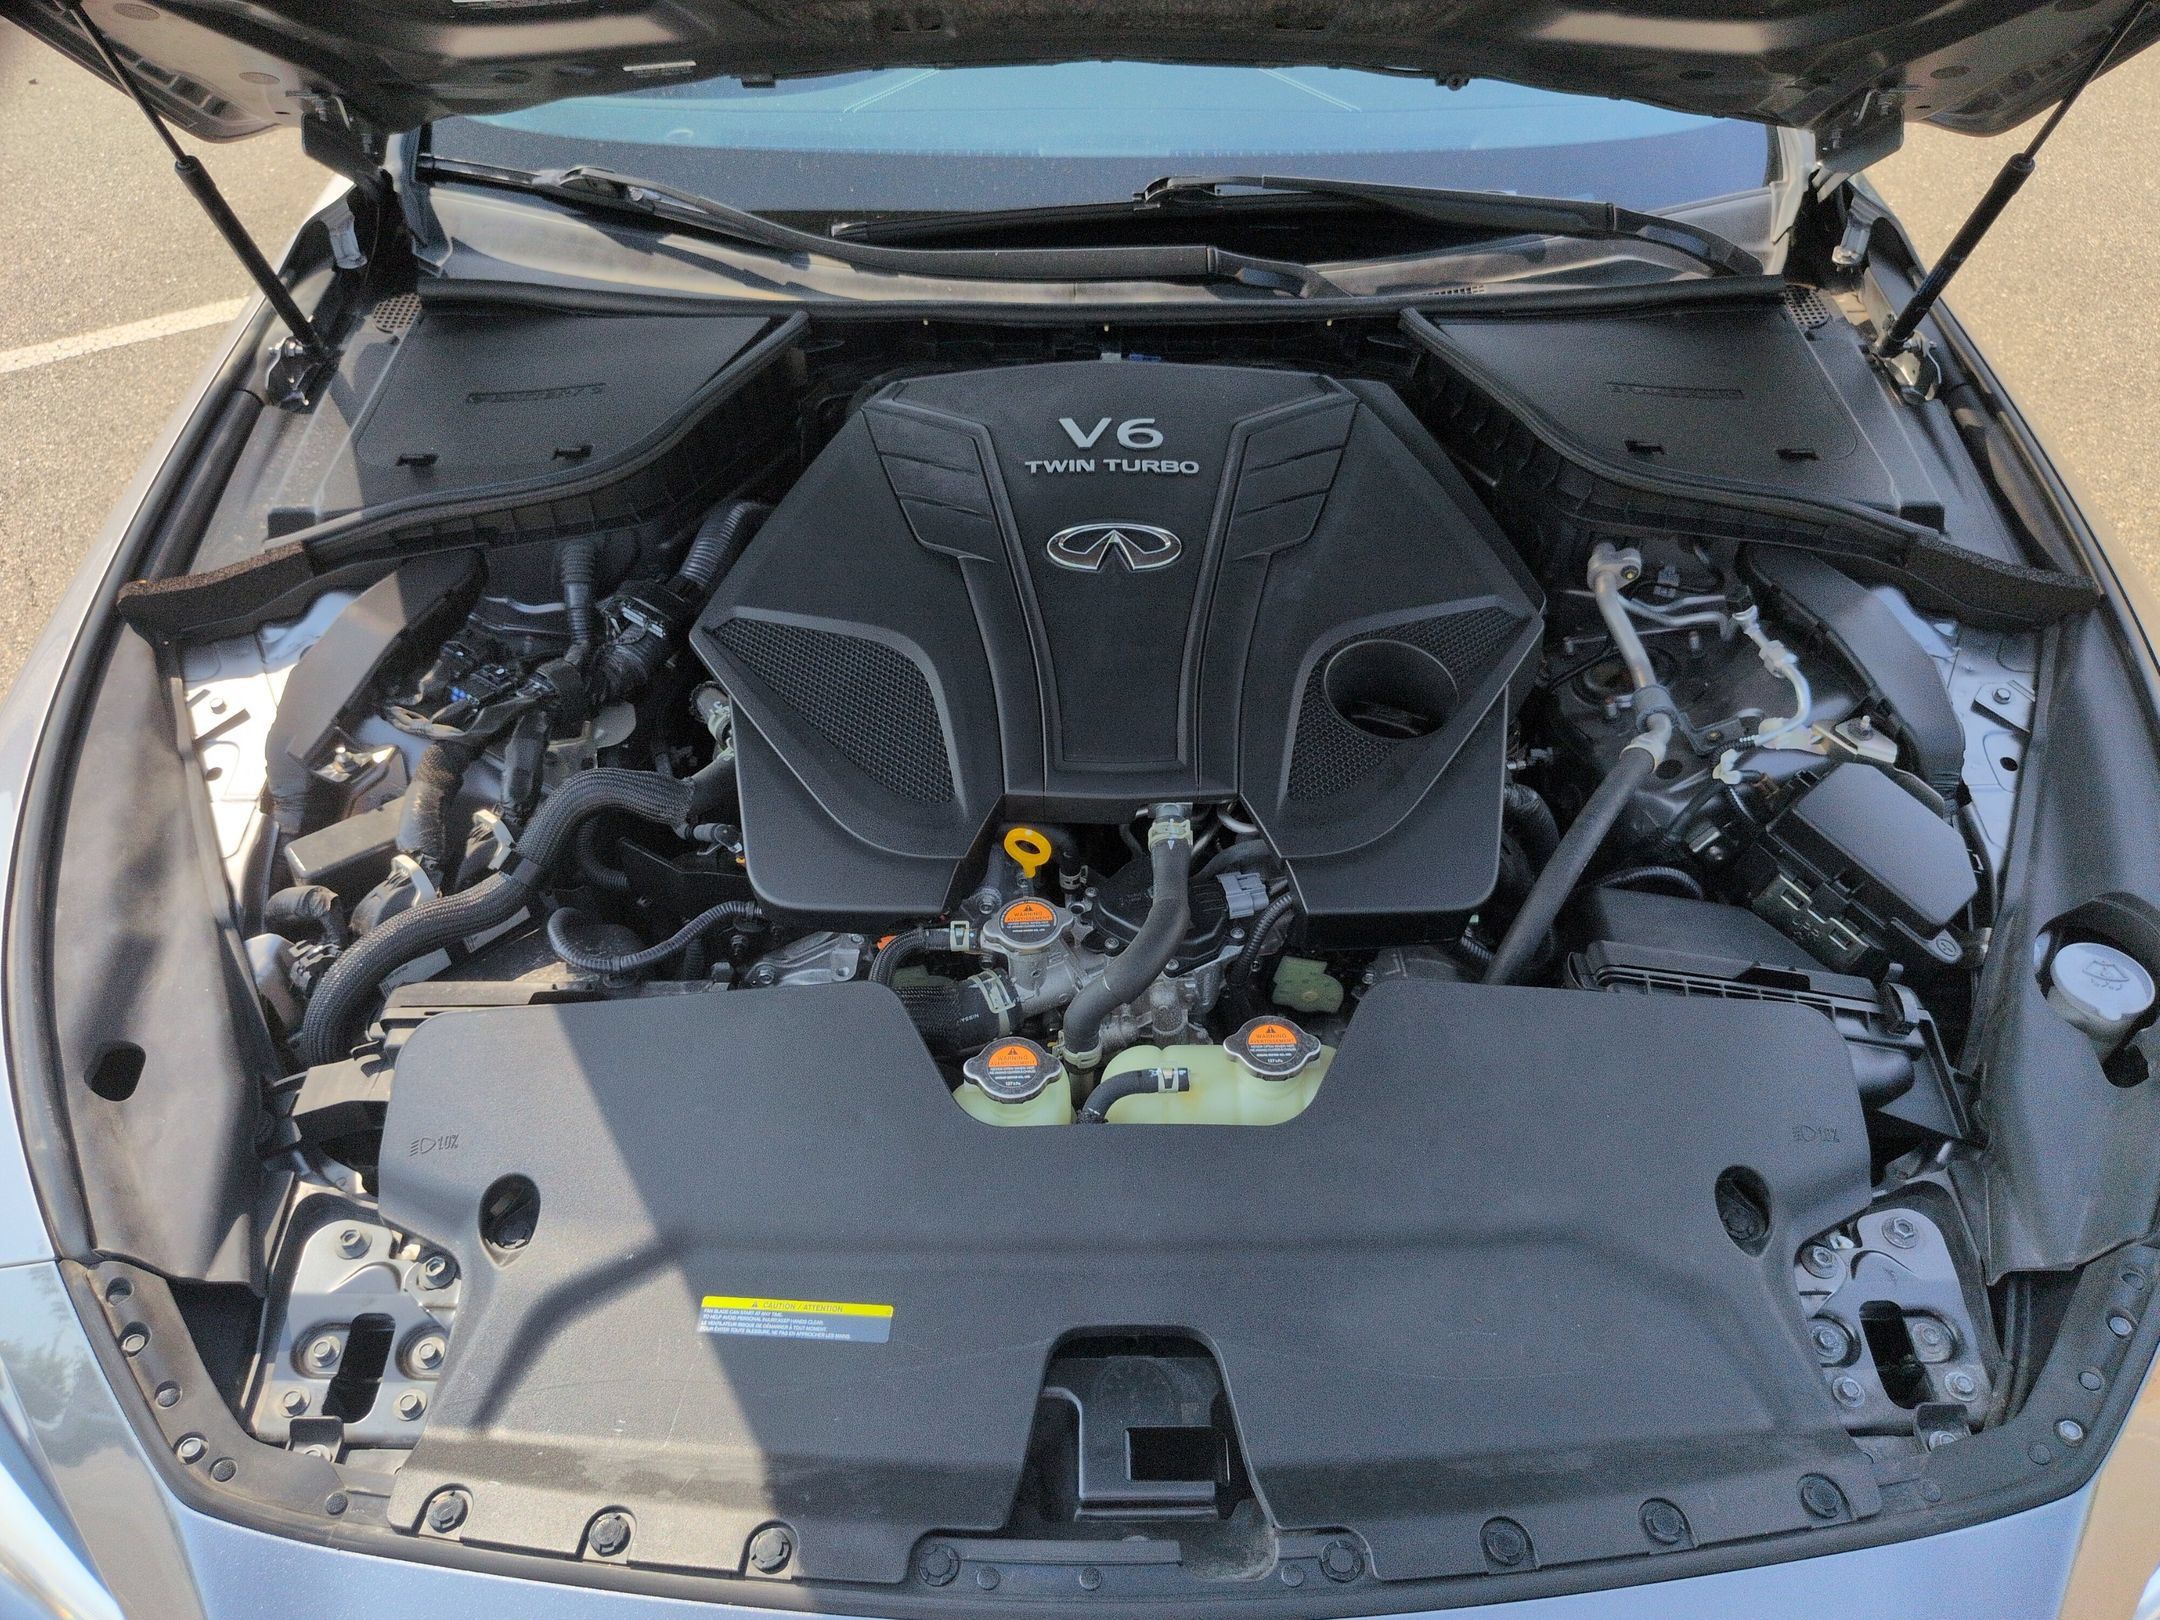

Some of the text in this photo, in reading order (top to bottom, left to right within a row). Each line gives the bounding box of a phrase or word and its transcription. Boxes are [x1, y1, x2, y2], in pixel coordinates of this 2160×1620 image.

[1058, 417, 1164, 449] V6
[1025, 459, 1200, 475] TWIN TURBO
[764, 1301, 795, 1309] CAUTION
[803, 1304, 844, 1312] ATTENTION
